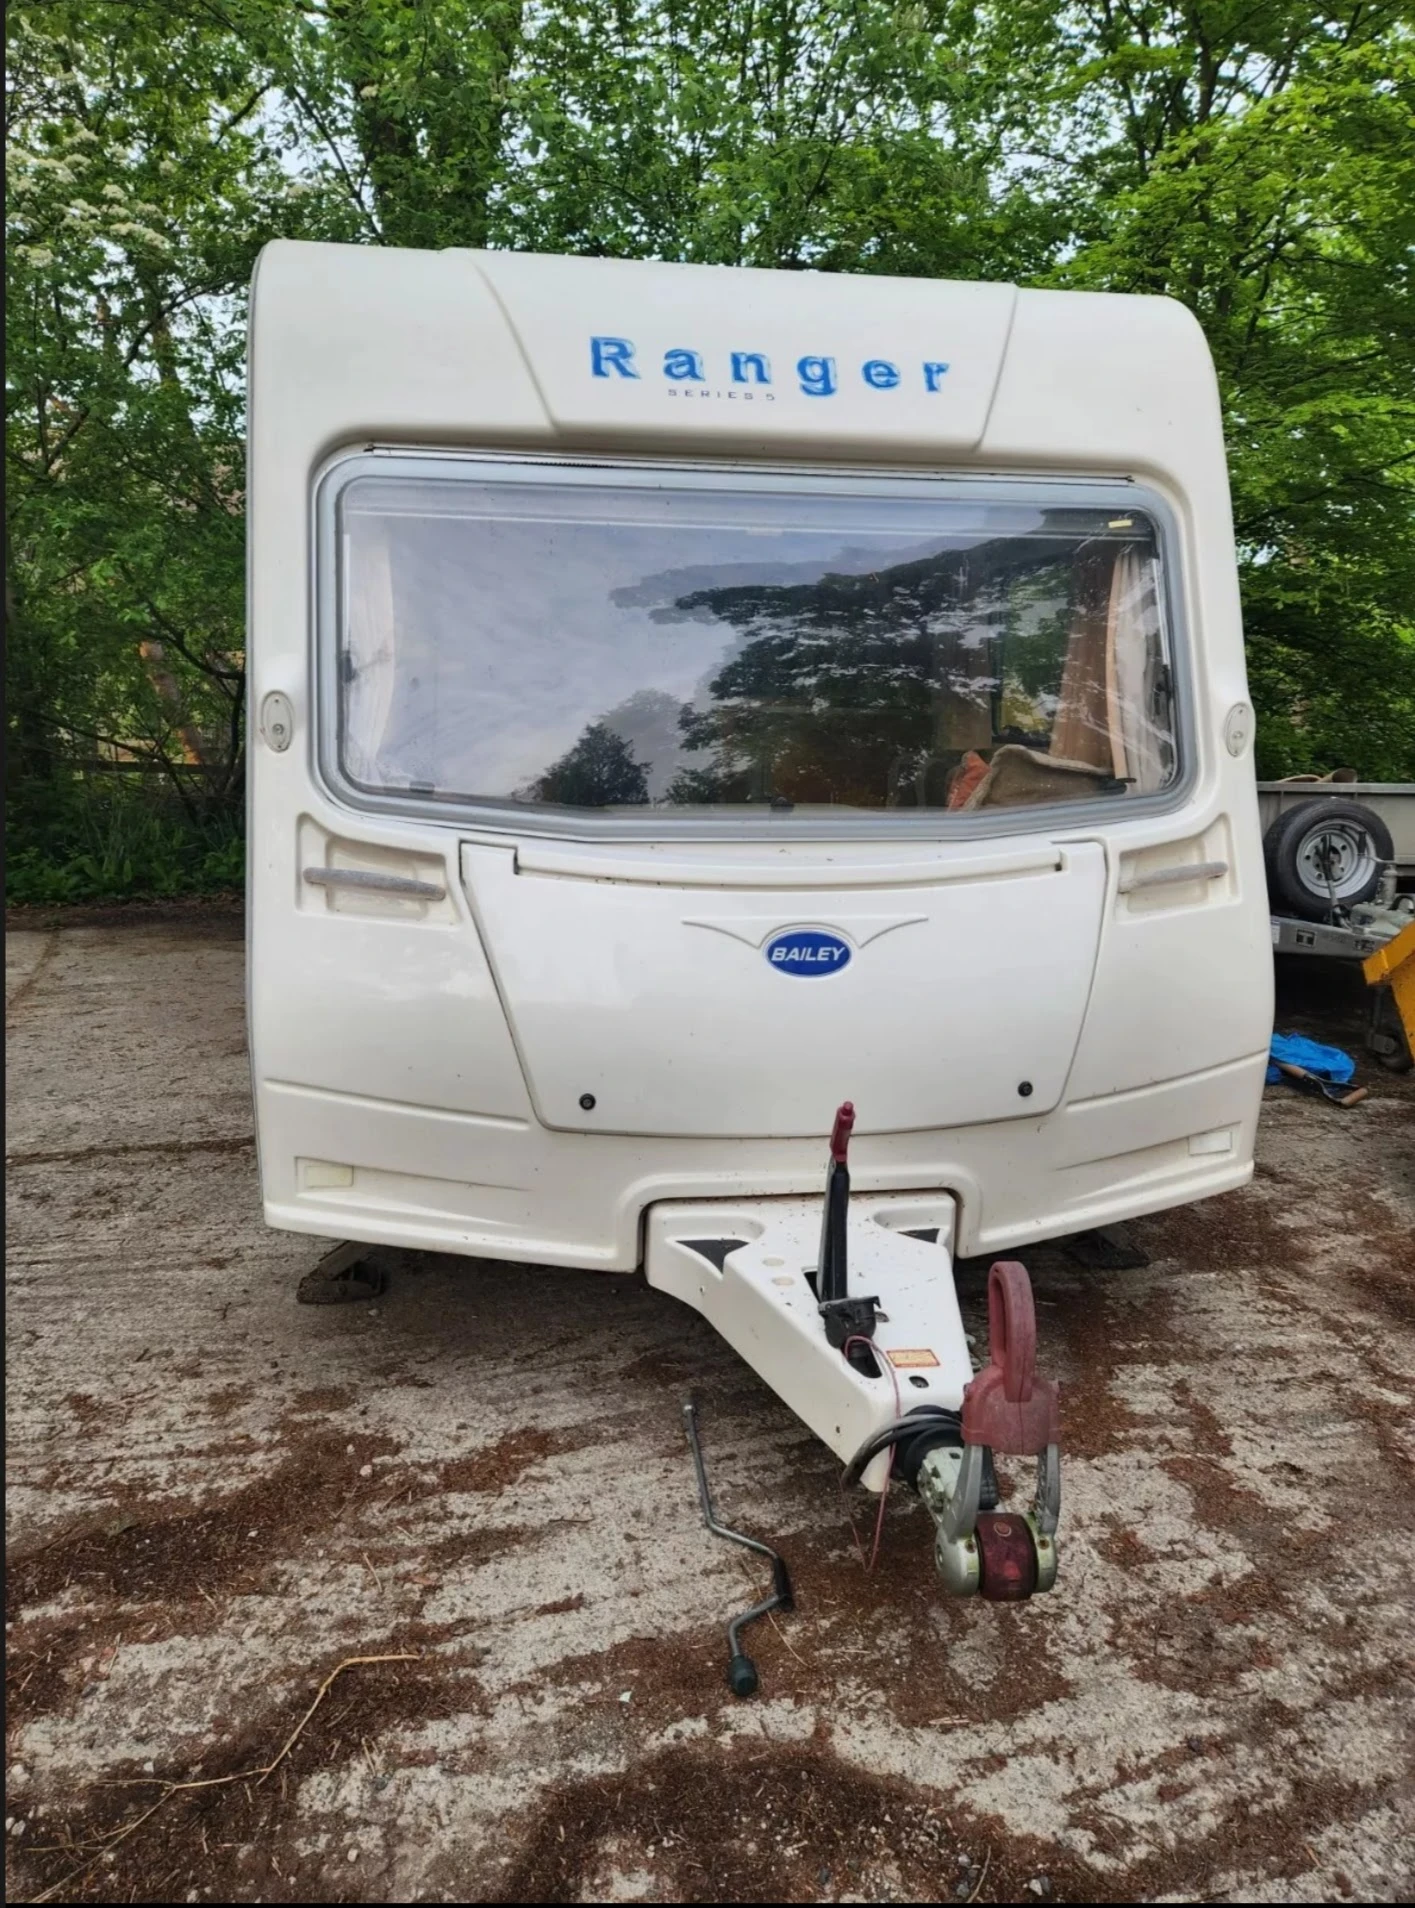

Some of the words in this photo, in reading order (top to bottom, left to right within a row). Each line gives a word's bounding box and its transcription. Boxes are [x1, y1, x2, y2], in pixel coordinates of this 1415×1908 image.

[590, 336, 949, 397] Ranger
[668, 389, 753, 400] SERIES
[771, 947, 845, 961] BAILEY
